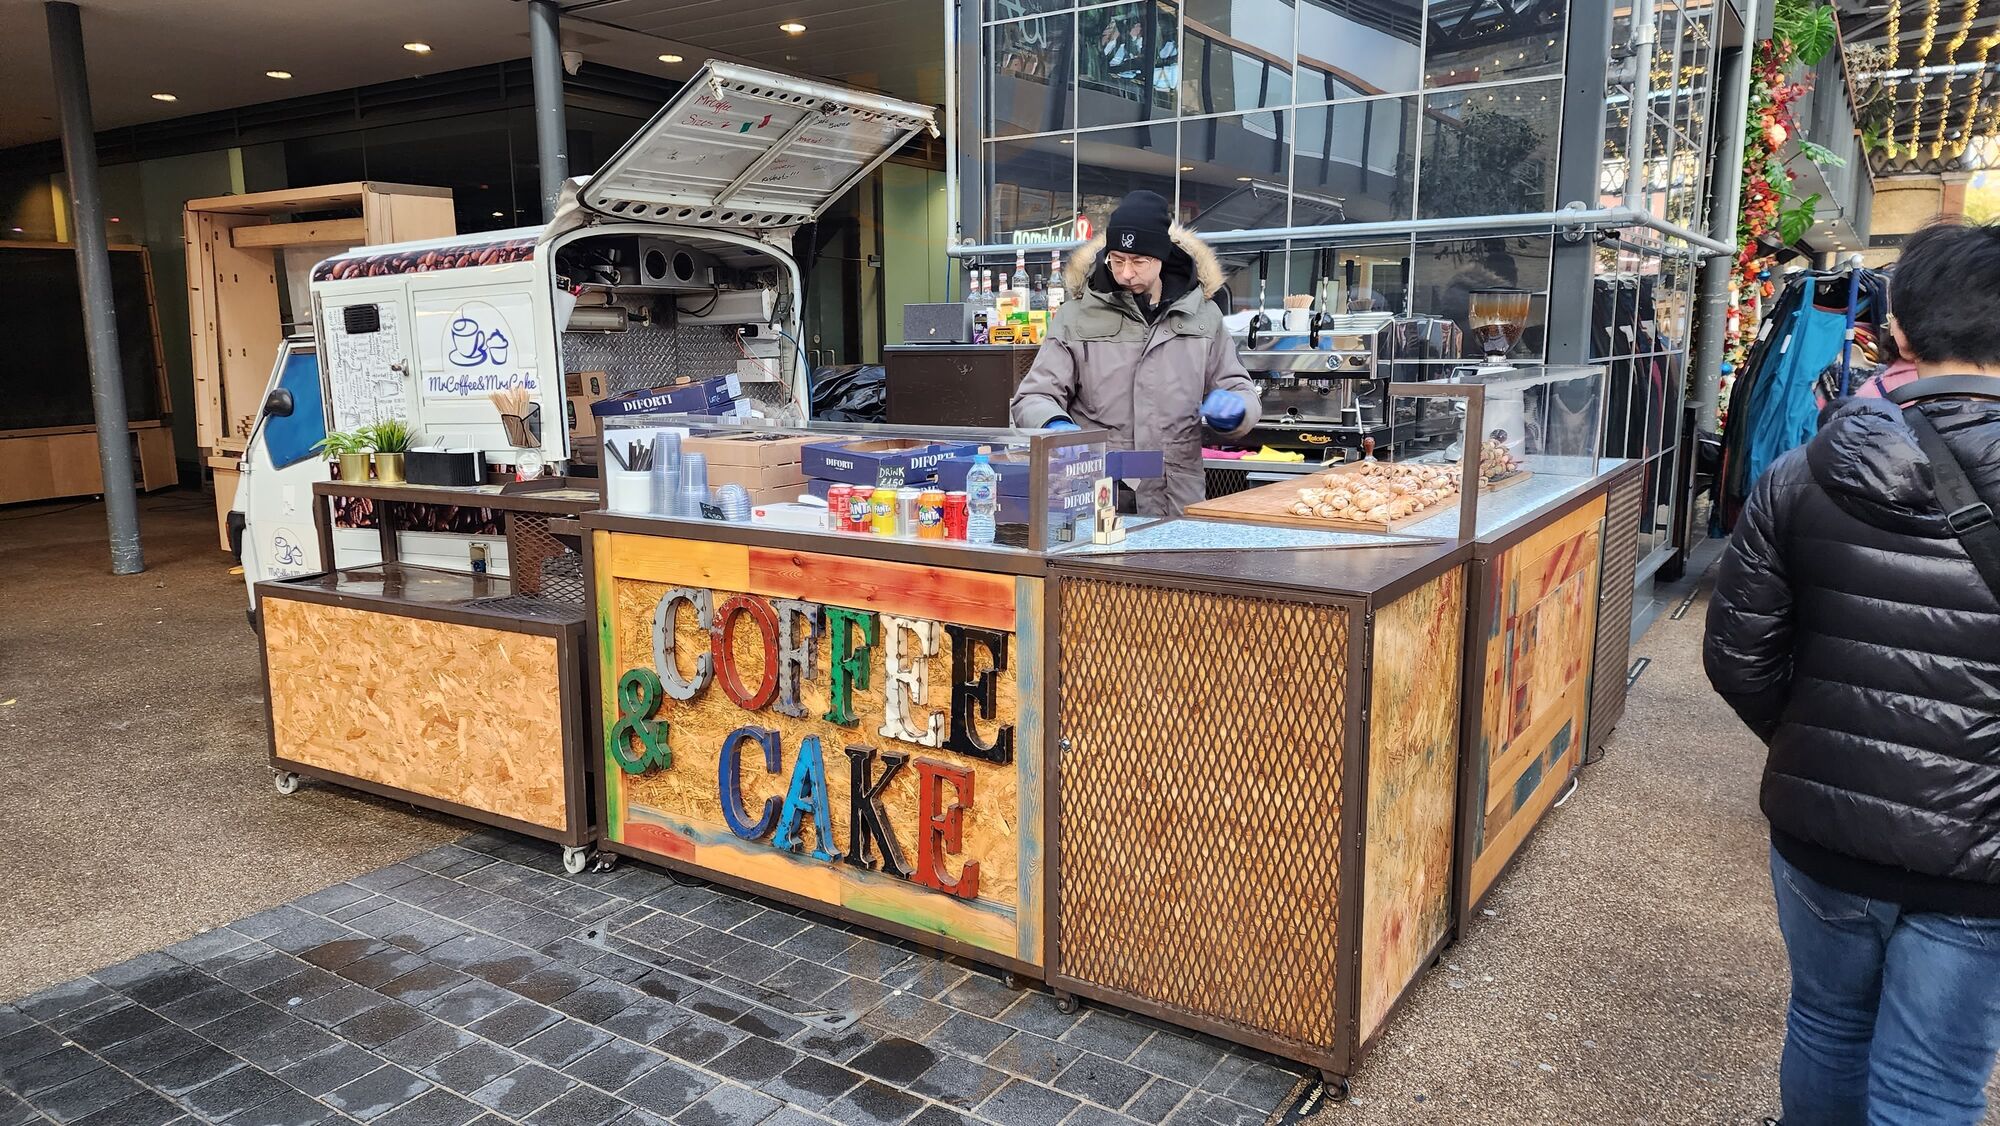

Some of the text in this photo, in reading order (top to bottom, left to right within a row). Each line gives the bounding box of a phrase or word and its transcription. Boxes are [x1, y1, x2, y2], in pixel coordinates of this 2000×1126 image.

[622, 394, 673, 412] DIFORTI
[825, 457, 854, 470] DIFORTI
[1065, 458, 1104, 478] DIFORTI
[1063, 490, 1096, 510] DIFORT
[919, 507, 940, 521] FANTA
[652, 588, 1014, 765] COFFEE
[611, 666, 981, 900] & CAKE
